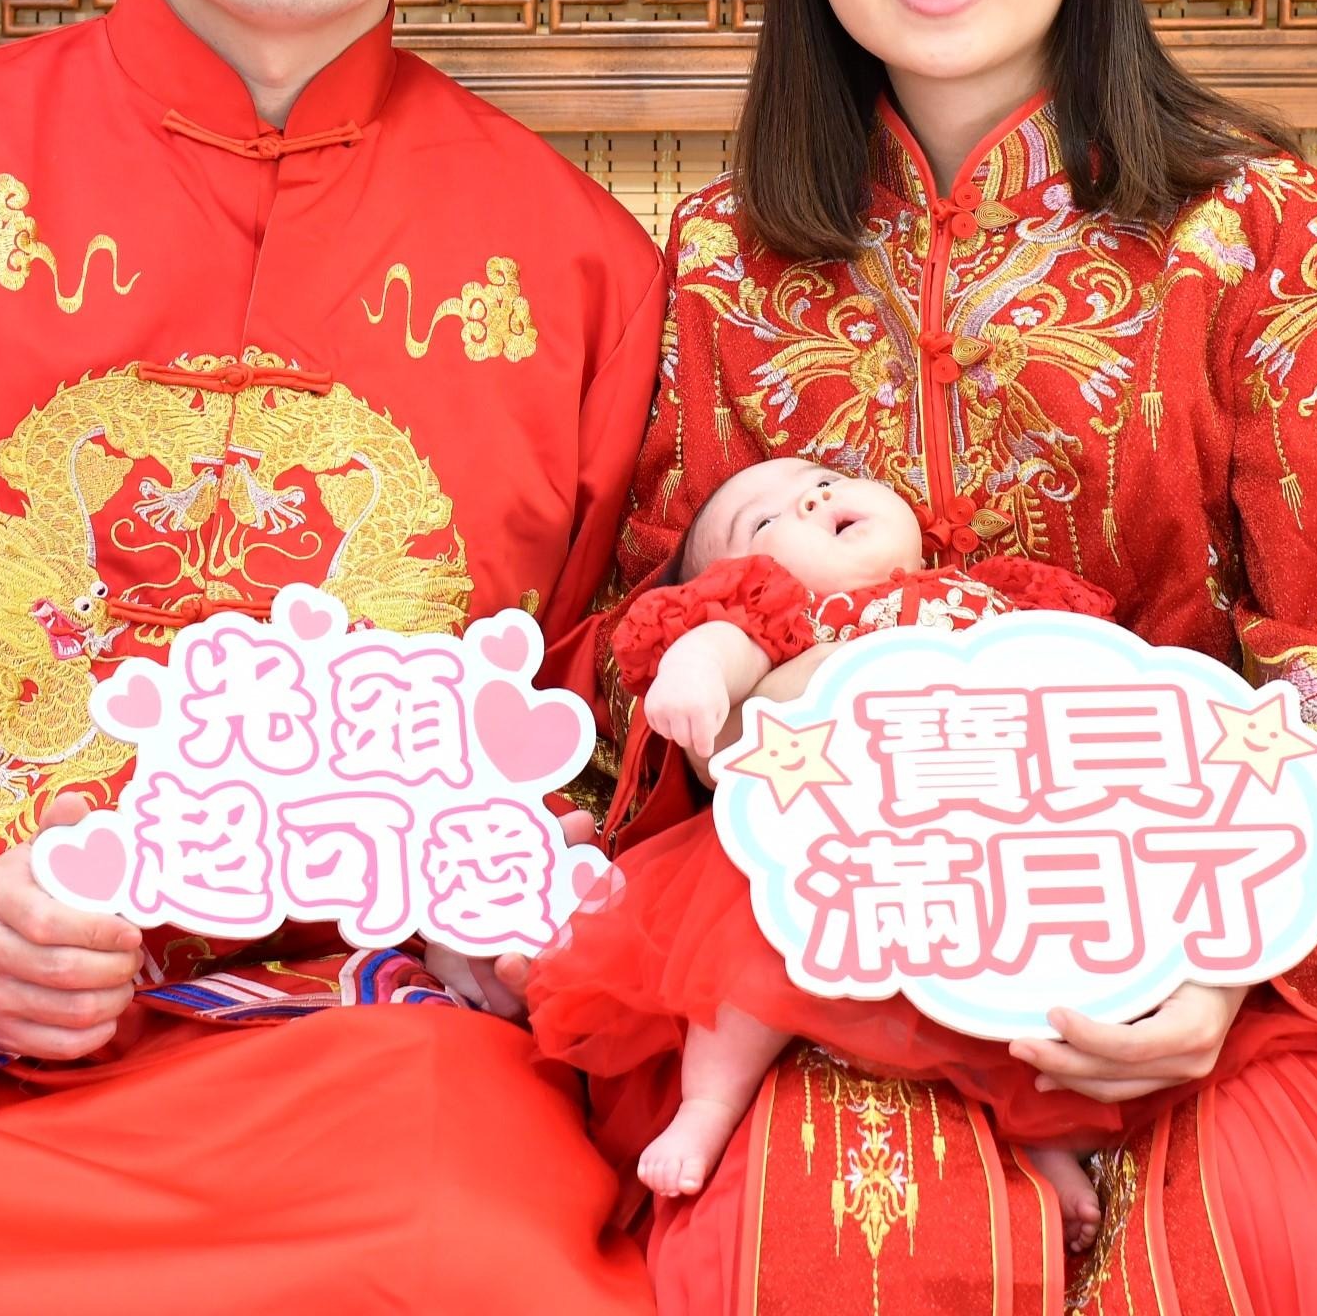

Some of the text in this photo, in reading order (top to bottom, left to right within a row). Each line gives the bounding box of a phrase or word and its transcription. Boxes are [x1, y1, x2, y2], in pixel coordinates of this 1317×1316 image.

[178, 626, 474, 787] 光頭
[852, 683, 1215, 827] 寶貝
[129, 771, 563, 949] 超可愛
[794, 823, 1307, 982] 滿月了
